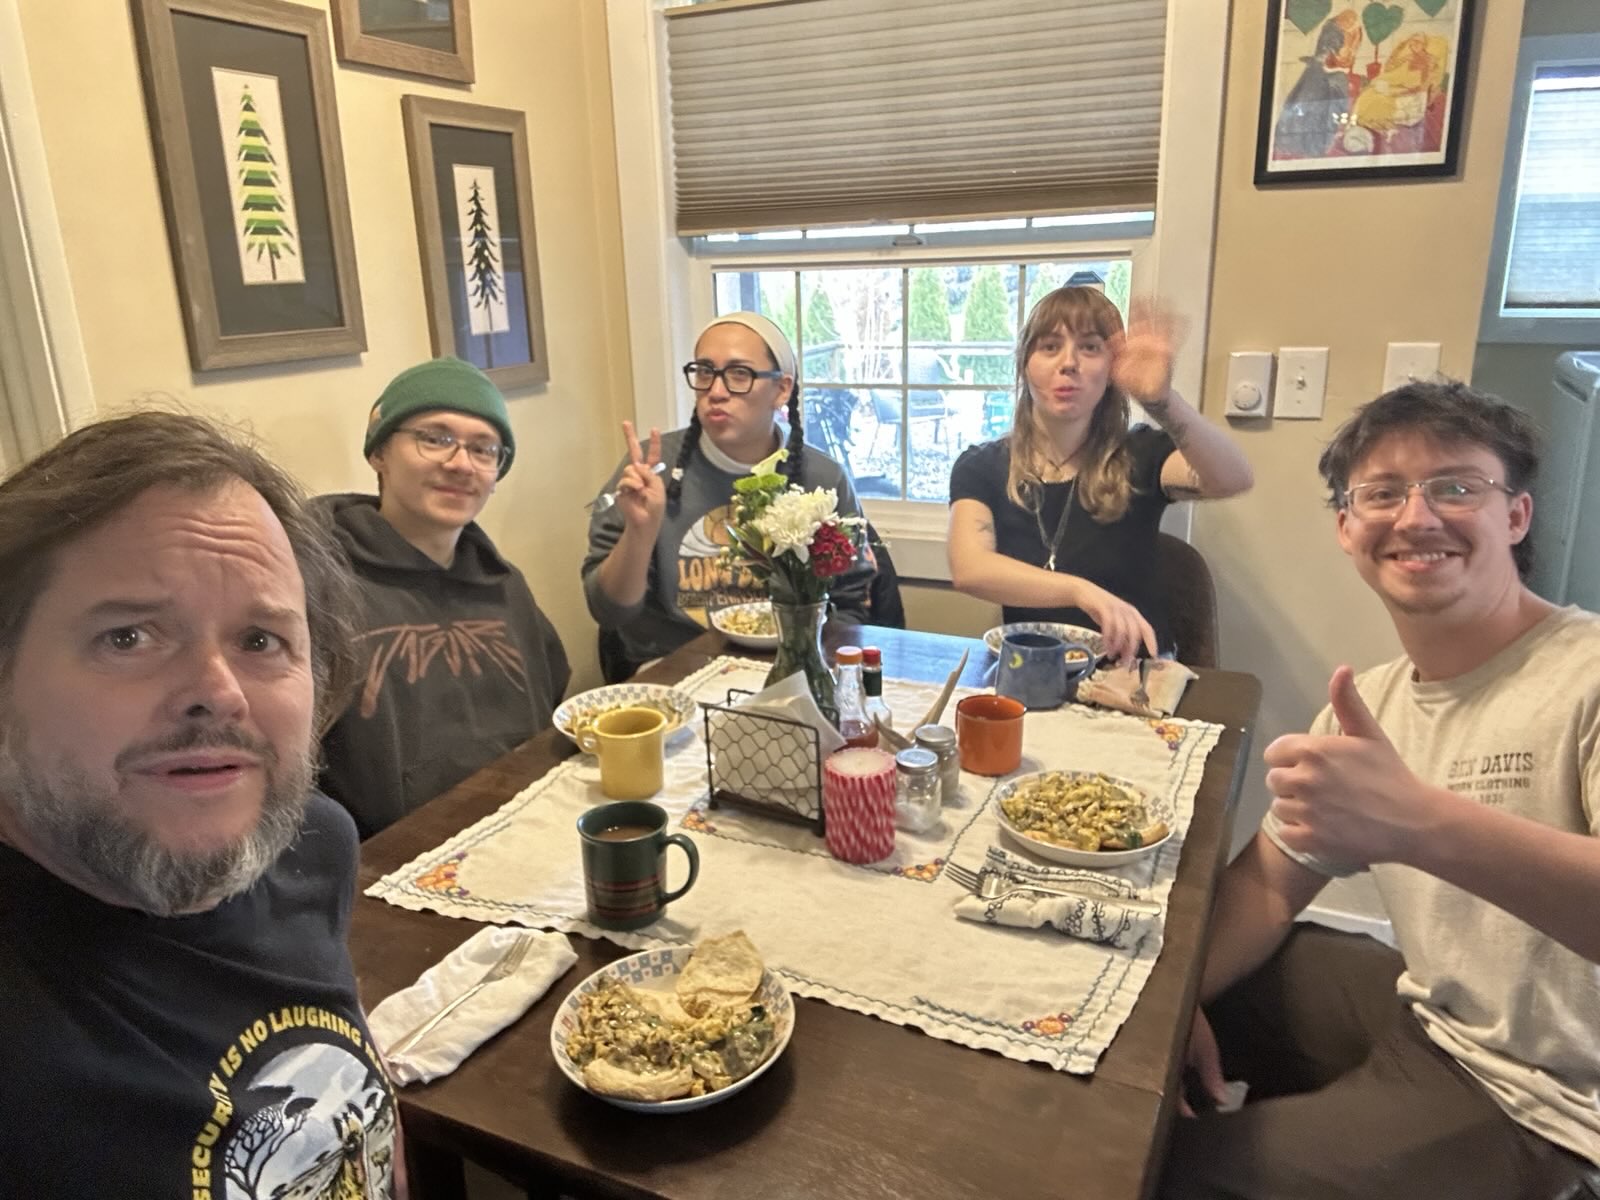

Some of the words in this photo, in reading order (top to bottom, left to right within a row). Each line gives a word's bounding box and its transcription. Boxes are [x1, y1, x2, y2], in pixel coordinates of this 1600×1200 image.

[1480, 752, 1534, 775] DAVIS
[1475, 777, 1531, 791] CLOTHING
[219, 1045, 243, 1078] IS
[239, 1019, 269, 1054] NO
[268, 1006, 362, 1048] LAUGHING
